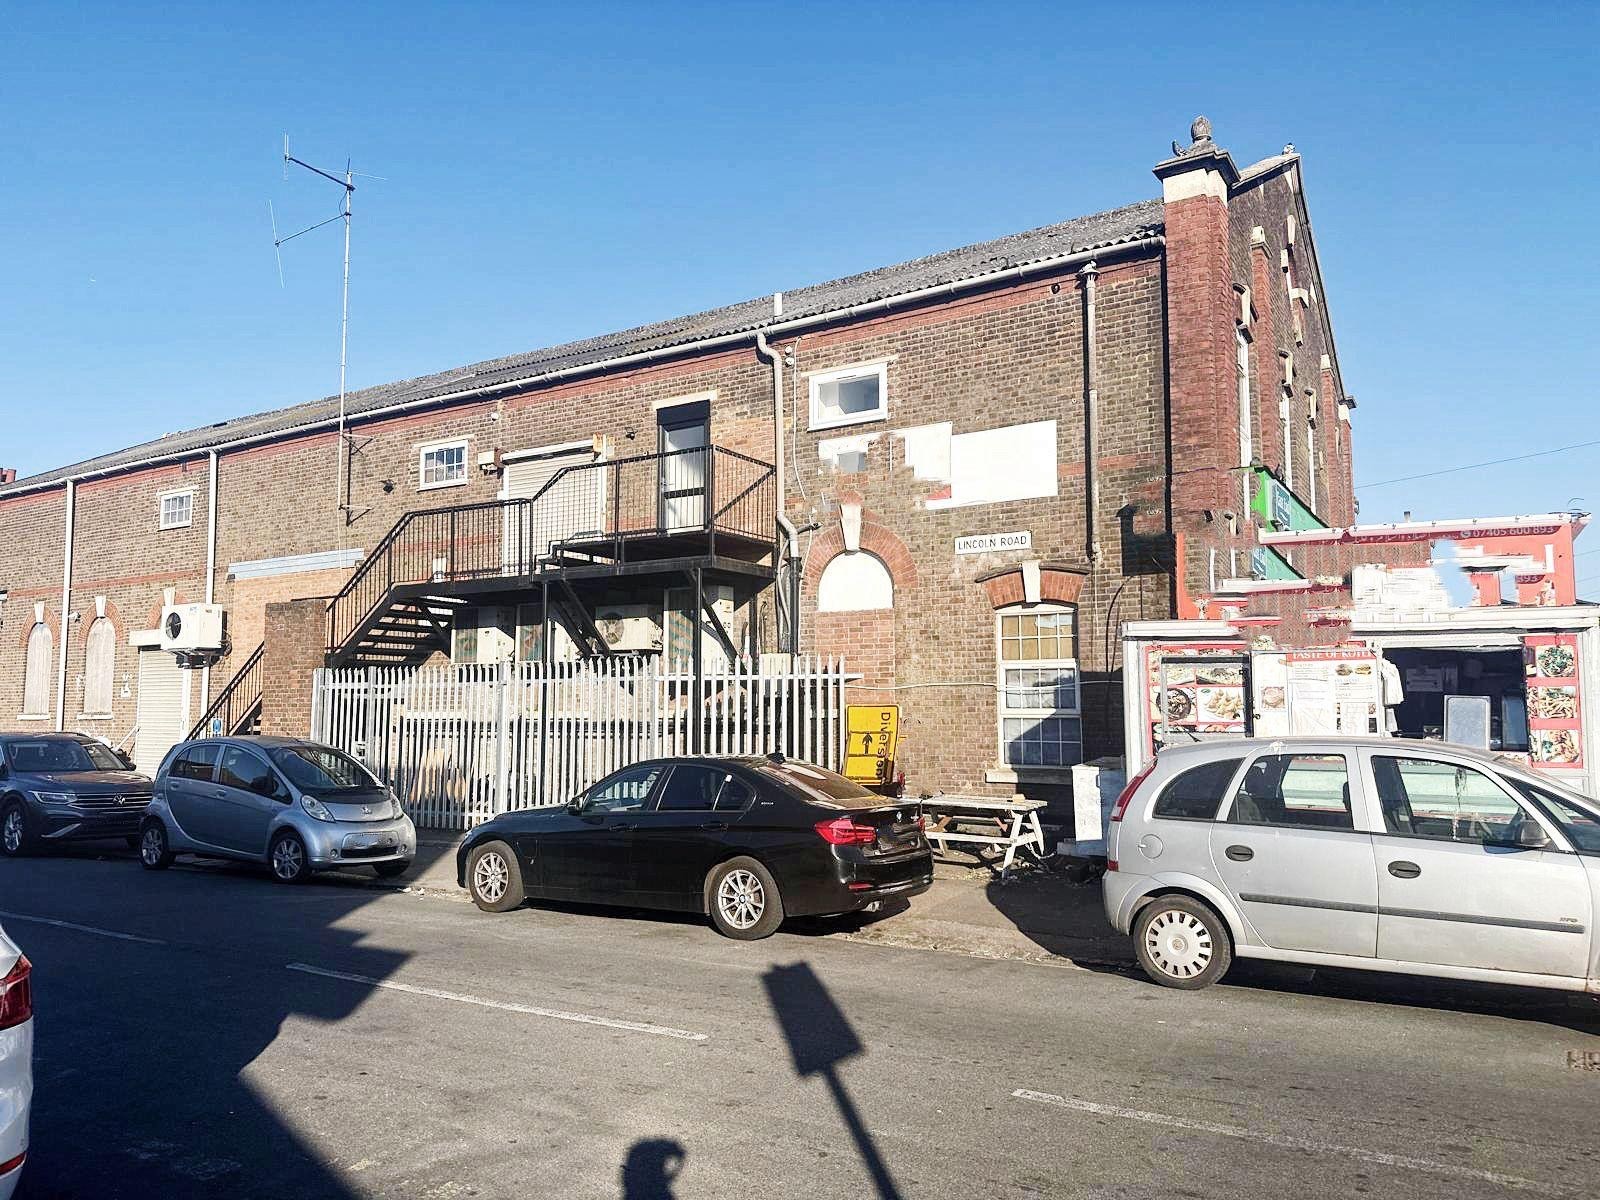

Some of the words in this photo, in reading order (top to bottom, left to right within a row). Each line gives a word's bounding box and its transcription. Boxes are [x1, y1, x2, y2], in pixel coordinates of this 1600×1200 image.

[958, 538, 997, 550] LINCOLN
[1001, 535, 1027, 547] ROAD
[1293, 651, 1324, 660] TASTE
[875, 711, 891, 777] Diversion
